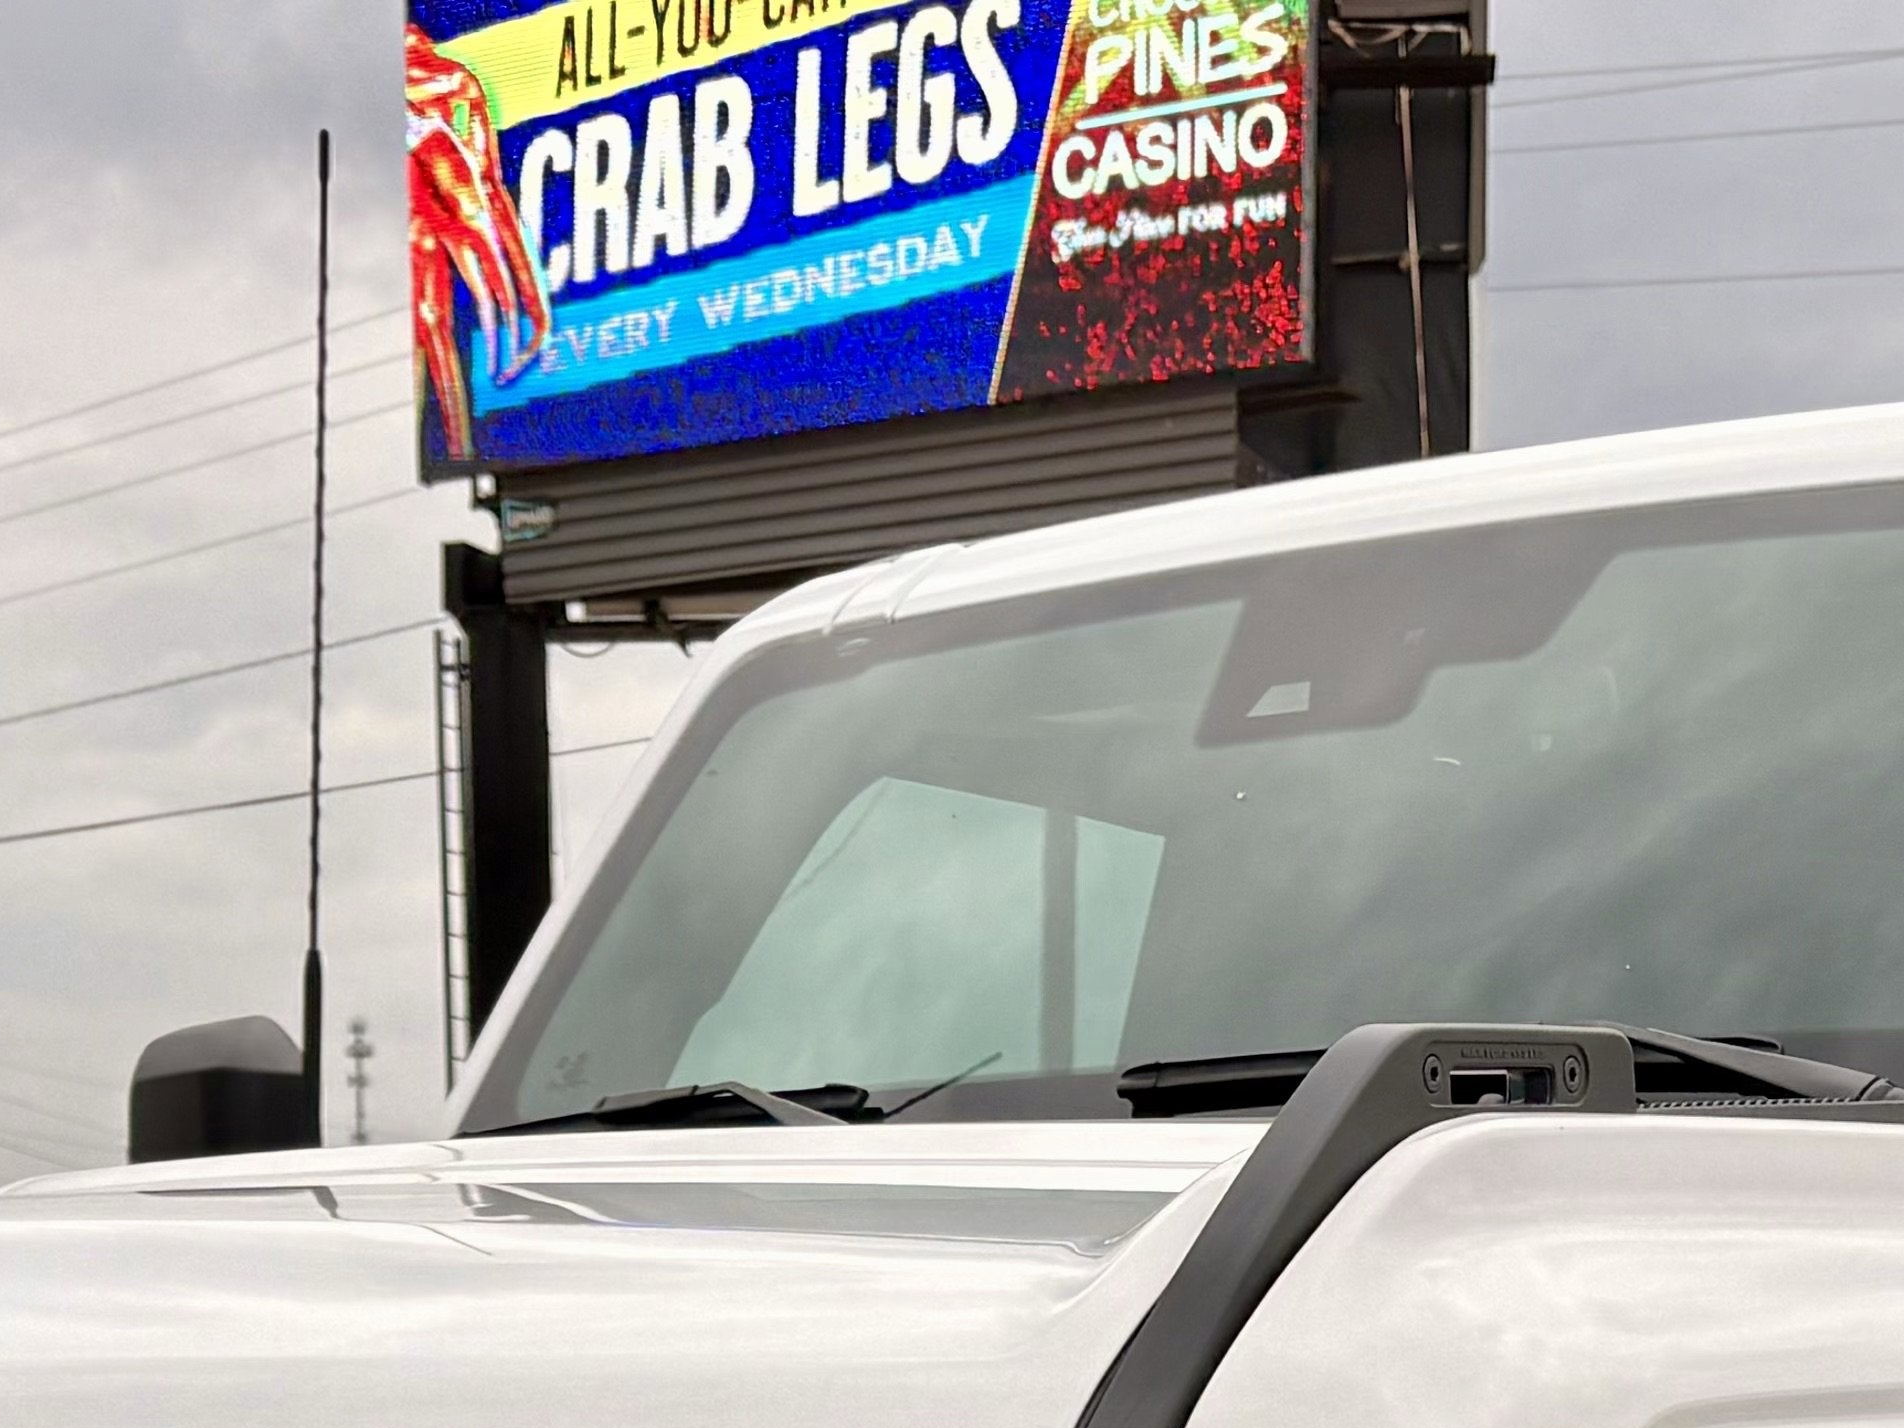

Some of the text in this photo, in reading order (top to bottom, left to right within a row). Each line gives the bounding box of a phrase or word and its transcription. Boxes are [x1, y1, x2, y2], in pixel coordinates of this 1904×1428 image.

[555, 0, 848, 98] ALL-YOU
[1084, 3, 1288, 104] PINES
[520, 0, 1021, 292] CRAB LEGS
[1052, 102, 1289, 199] CASINO
[539, 300, 679, 374] EVERY
[698, 214, 990, 330] WEDNESDAY
